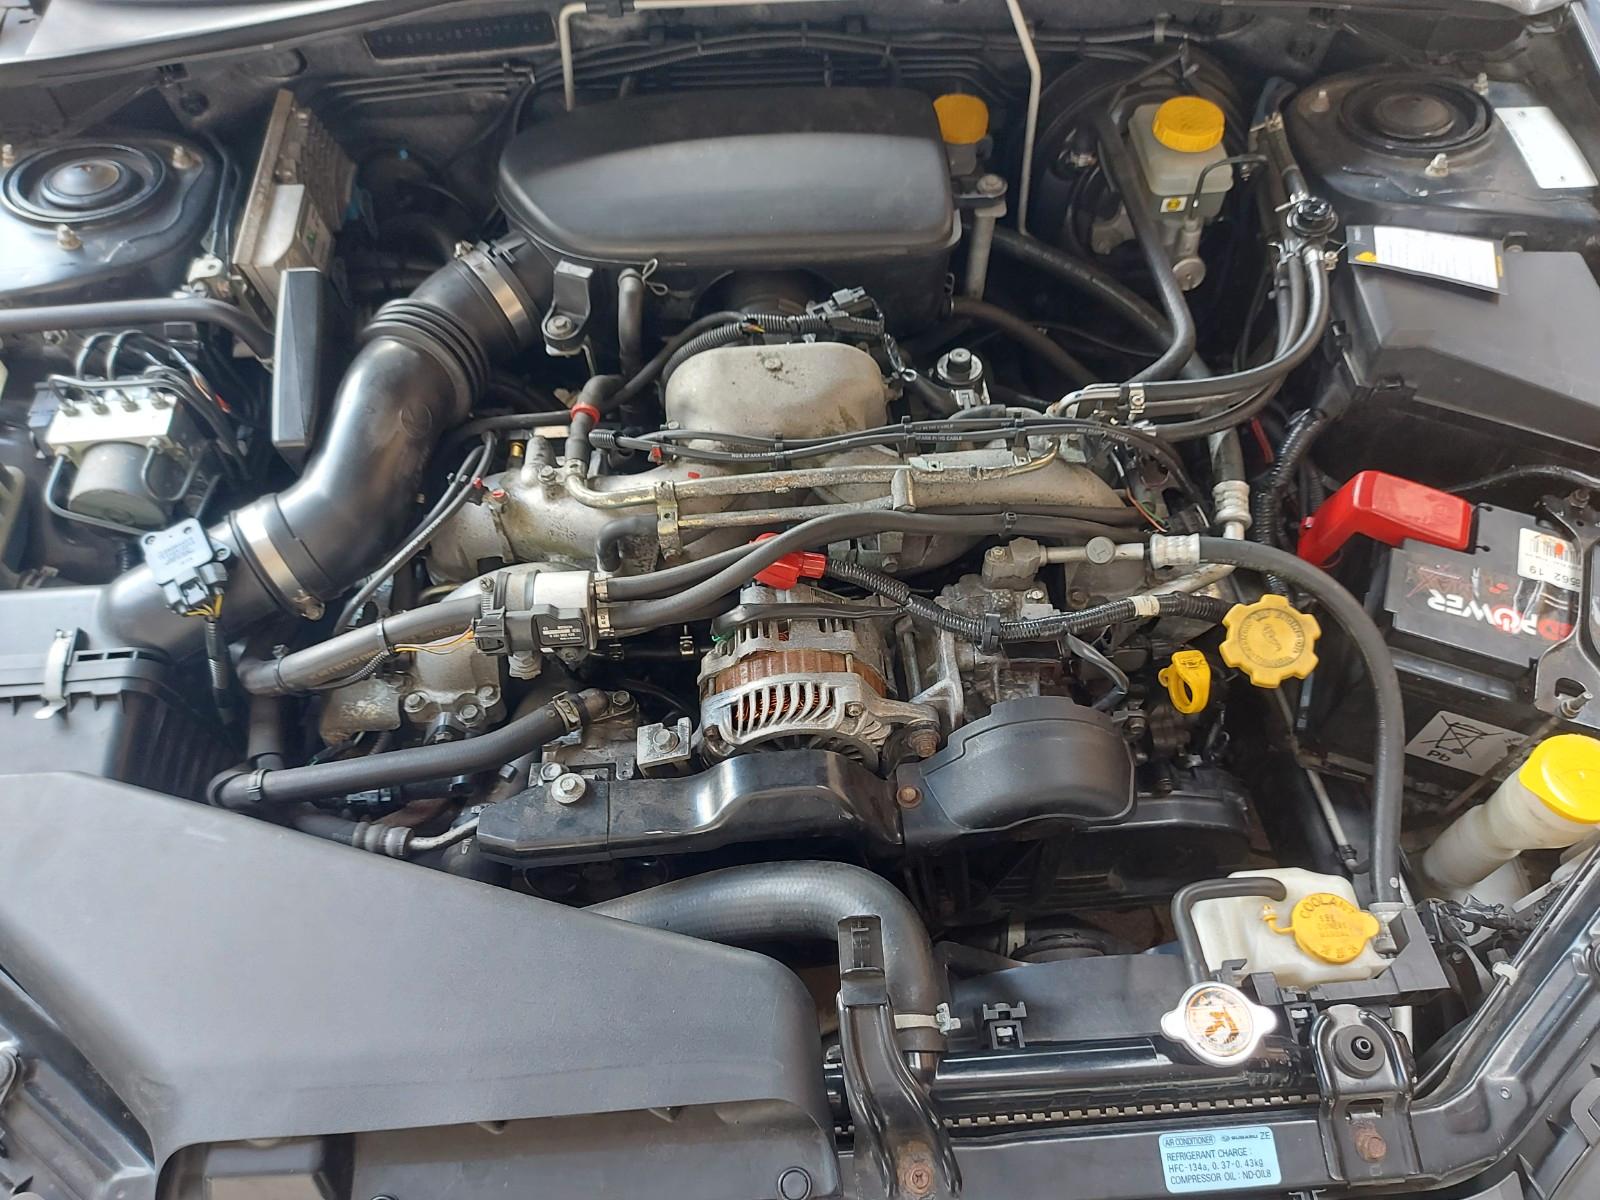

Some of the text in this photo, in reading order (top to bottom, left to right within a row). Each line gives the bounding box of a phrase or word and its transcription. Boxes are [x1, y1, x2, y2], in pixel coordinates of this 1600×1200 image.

[1426, 749, 1452, 763] Pb
[1165, 1135, 1214, 1147] AIR CONDITIONER
[1166, 1149, 1215, 1162] REFRIGERANT
[1217, 1147, 1248, 1158] CHARGE
[1170, 1172, 1222, 1185] COMPRESSOR
